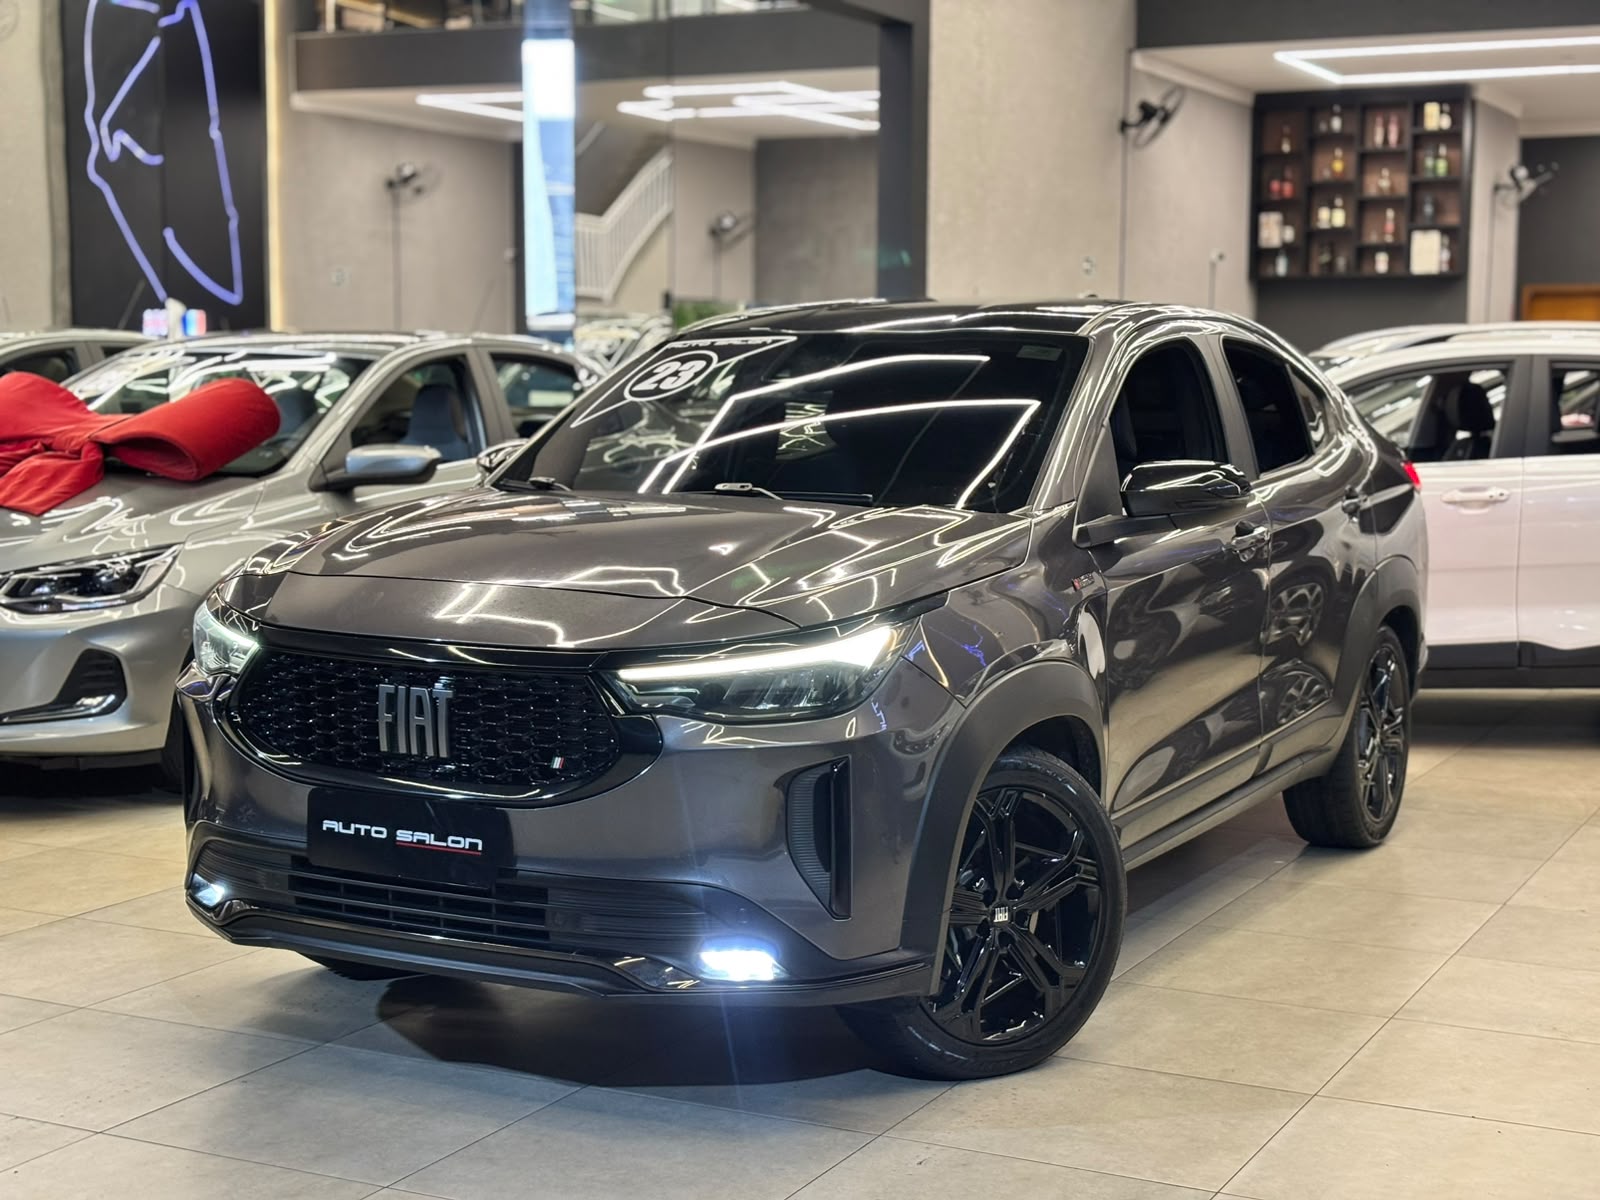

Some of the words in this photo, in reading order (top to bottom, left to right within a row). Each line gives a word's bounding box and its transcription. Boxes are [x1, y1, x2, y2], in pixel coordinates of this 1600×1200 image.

[631, 359, 707, 391] 23
[378, 684, 453, 758] FIAT
[322, 819, 388, 839] AUTO
[396, 829, 483, 851] SALON
